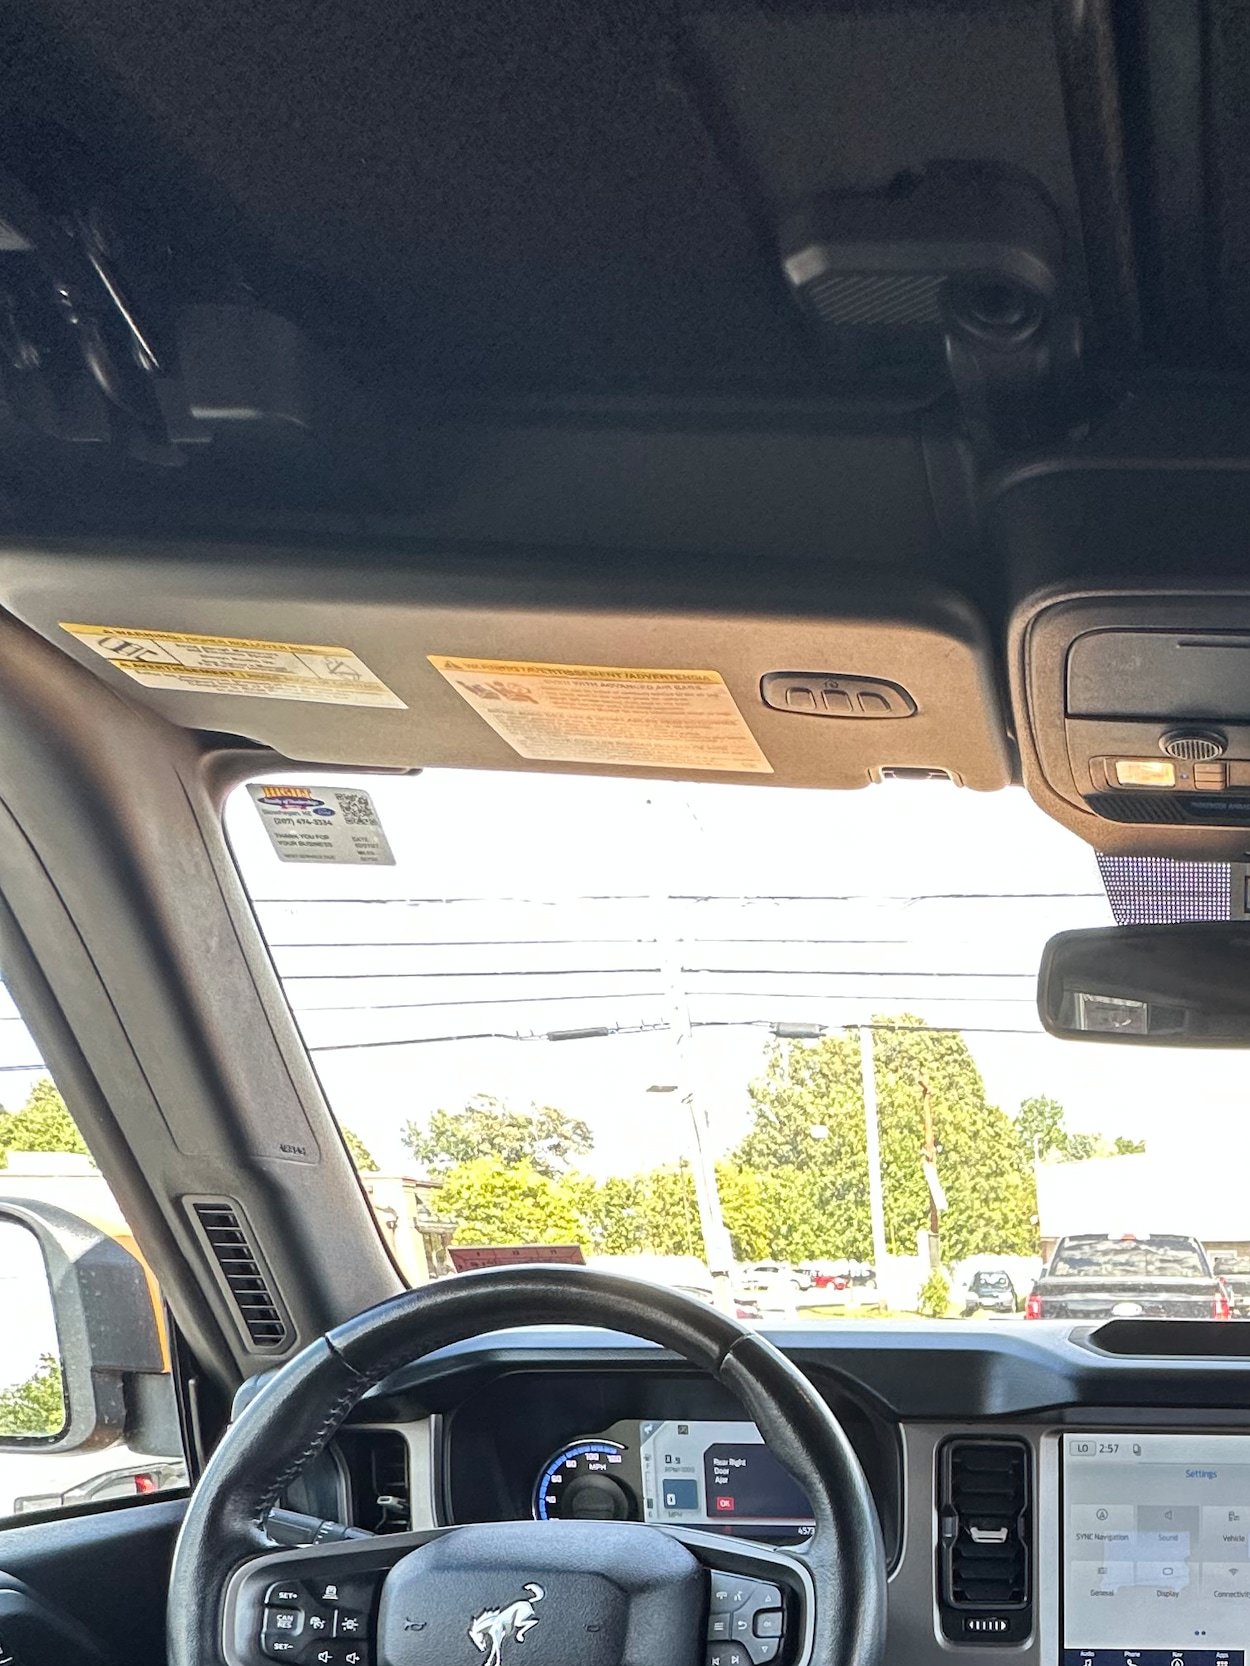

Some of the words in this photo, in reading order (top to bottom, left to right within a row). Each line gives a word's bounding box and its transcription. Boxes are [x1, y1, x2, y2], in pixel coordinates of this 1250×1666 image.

[1099, 1444, 1119, 1453] 2:57
[713, 1467, 729, 1475] Door
[1185, 1469, 1218, 1480] Settings
[1076, 1533, 1093, 1541] SYNC
[1094, 1533, 1129, 1543] Navigation
[1158, 1533, 1178, 1542] Sound
[1223, 1534, 1246, 1542] Vehicle
[1090, 1589, 1114, 1597] General
[1156, 1590, 1179, 1599] Display
[1216, 1651, 1229, 1659] Apps
